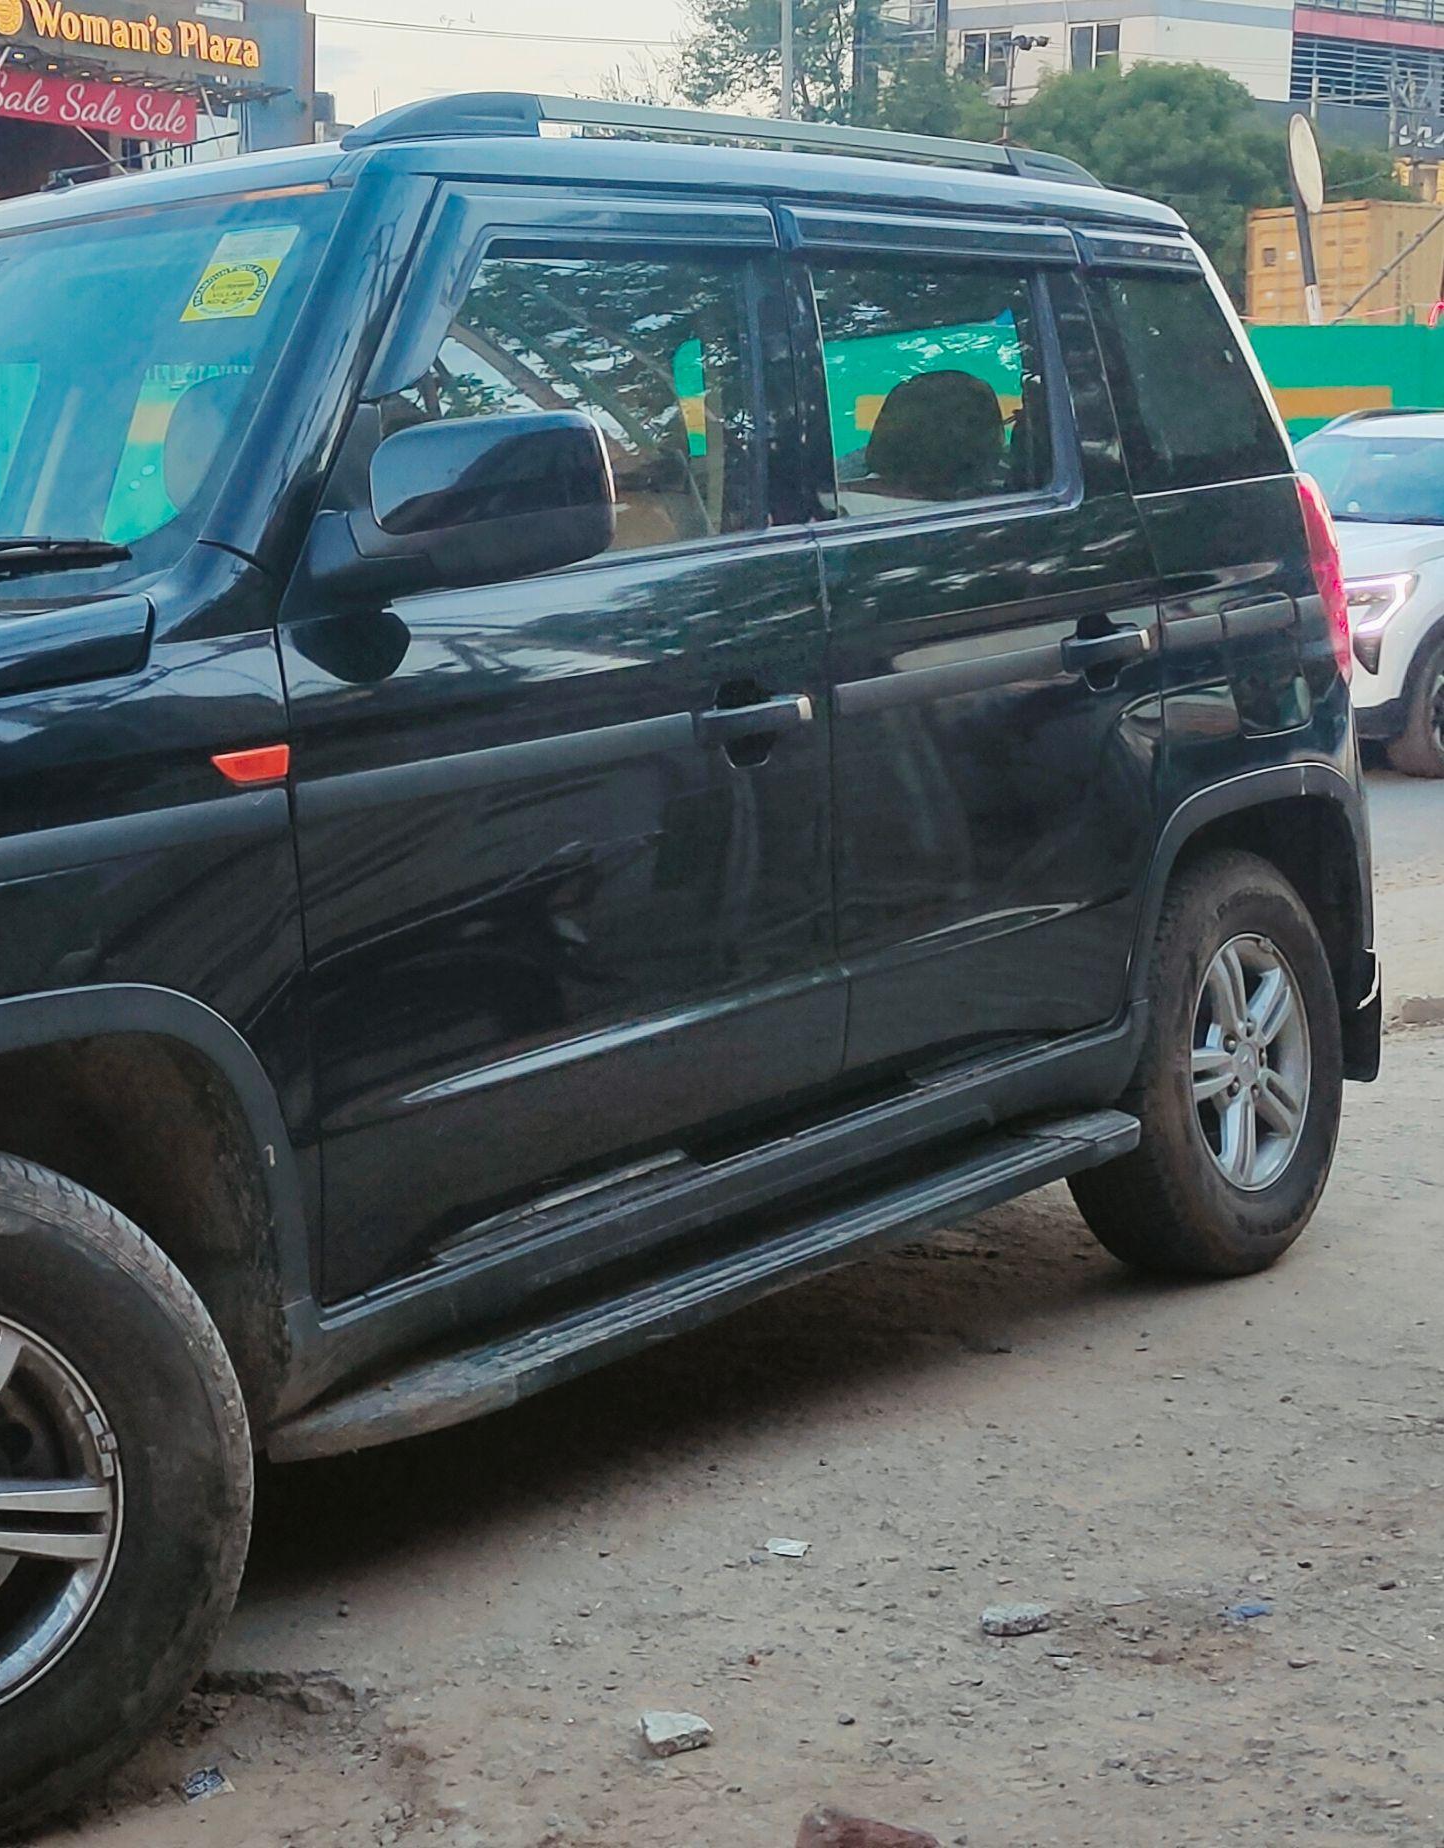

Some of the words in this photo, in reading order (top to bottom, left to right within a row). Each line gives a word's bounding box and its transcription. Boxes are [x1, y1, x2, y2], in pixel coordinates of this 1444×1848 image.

[26, 0, 173, 55] Woman's
[177, 20, 260, 68] Plaza
[60, 83, 122, 126] Sale
[130, 98, 188, 134] Sale
